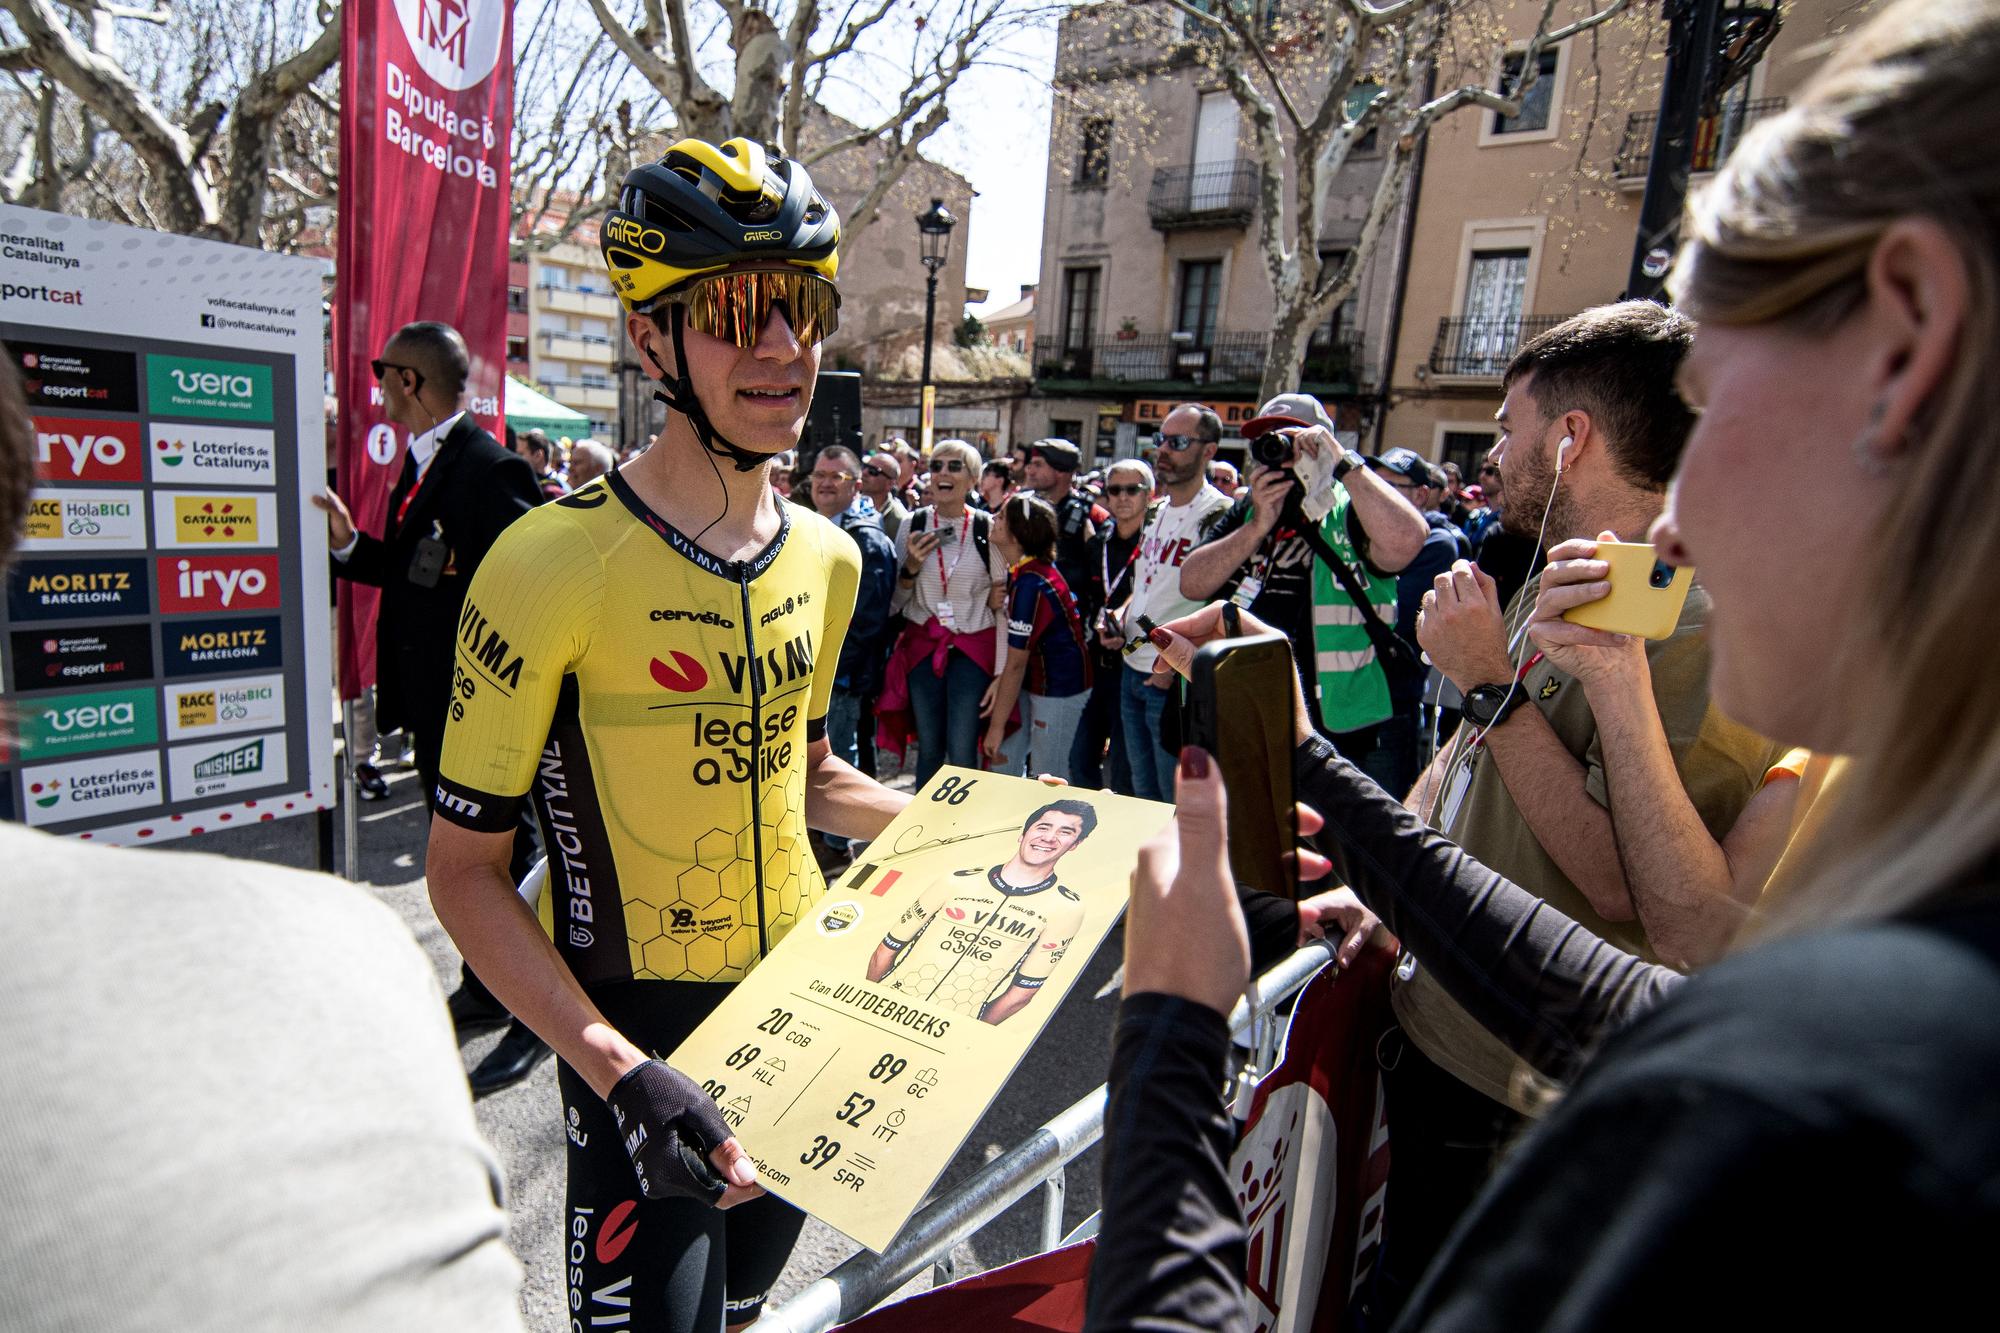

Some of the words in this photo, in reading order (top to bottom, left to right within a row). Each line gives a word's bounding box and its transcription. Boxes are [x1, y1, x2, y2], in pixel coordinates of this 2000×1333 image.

[607, 216, 665, 253] GIRO
[744, 231, 782, 241] GIRO
[3, 246, 80, 269] Catalunya
[0, 284, 83, 305] portcat
[207, 298, 296, 317] voltacatalunya.cat
[217, 318, 296, 336] @voltacatalunya
[43, 385, 108, 399] esportcat
[170, 369, 252, 397] vera
[35, 432, 126, 477] ryo
[193, 441, 255, 456] Loteries
[257, 448, 269, 457] de
[193, 454, 270, 472] Catalunya
[183, 514, 252, 525] CATALUNYA
[672, 533, 723, 574] VISMA
[754, 543, 782, 572] lease
[28, 572, 131, 593] MORITZ
[177, 559, 267, 608] iryo
[41, 591, 122, 606] BARCELONA
[650, 609, 735, 629] cervélo
[761, 604, 786, 627] AGU
[180, 629, 267, 651] MORITZ
[458, 598, 524, 689] VISMA
[191, 646, 258, 661] BARCELONA
[62, 661, 124, 677] esportcat
[180, 693, 214, 708] RACC
[43, 702, 134, 731] vera
[694, 705, 797, 748] lease
[196, 745, 258, 778] FINISHER
[70, 769, 139, 789] Loteries
[140, 769, 154, 778] de
[71, 778, 155, 802] Catalunya
[931, 776, 978, 805] 86
[541, 740, 593, 924] BETCITY.NL
[700, 915, 732, 926] beyond
[974, 910, 1036, 939] VISMA
[948, 926, 1002, 950] lease
[809, 979, 832, 995] Cian
[832, 983, 950, 1038] UIJTDEBROEKS
[757, 1007, 793, 1036] 20
[785, 1031, 812, 1048] COB
[725, 1042, 761, 1071] 69
[752, 1068, 776, 1087] HLL
[869, 1053, 907, 1084] 89
[907, 1083, 928, 1099] GC
[720, 1106, 745, 1127] MTN
[836, 1091, 876, 1128] 52
[872, 1124, 898, 1143] ITT
[566, 1119, 588, 1147] AGU
[800, 1135, 841, 1171] 39
[833, 1168, 865, 1193] SPR
[570, 1206, 594, 1312] lease
[725, 1290, 768, 1311] AGU
